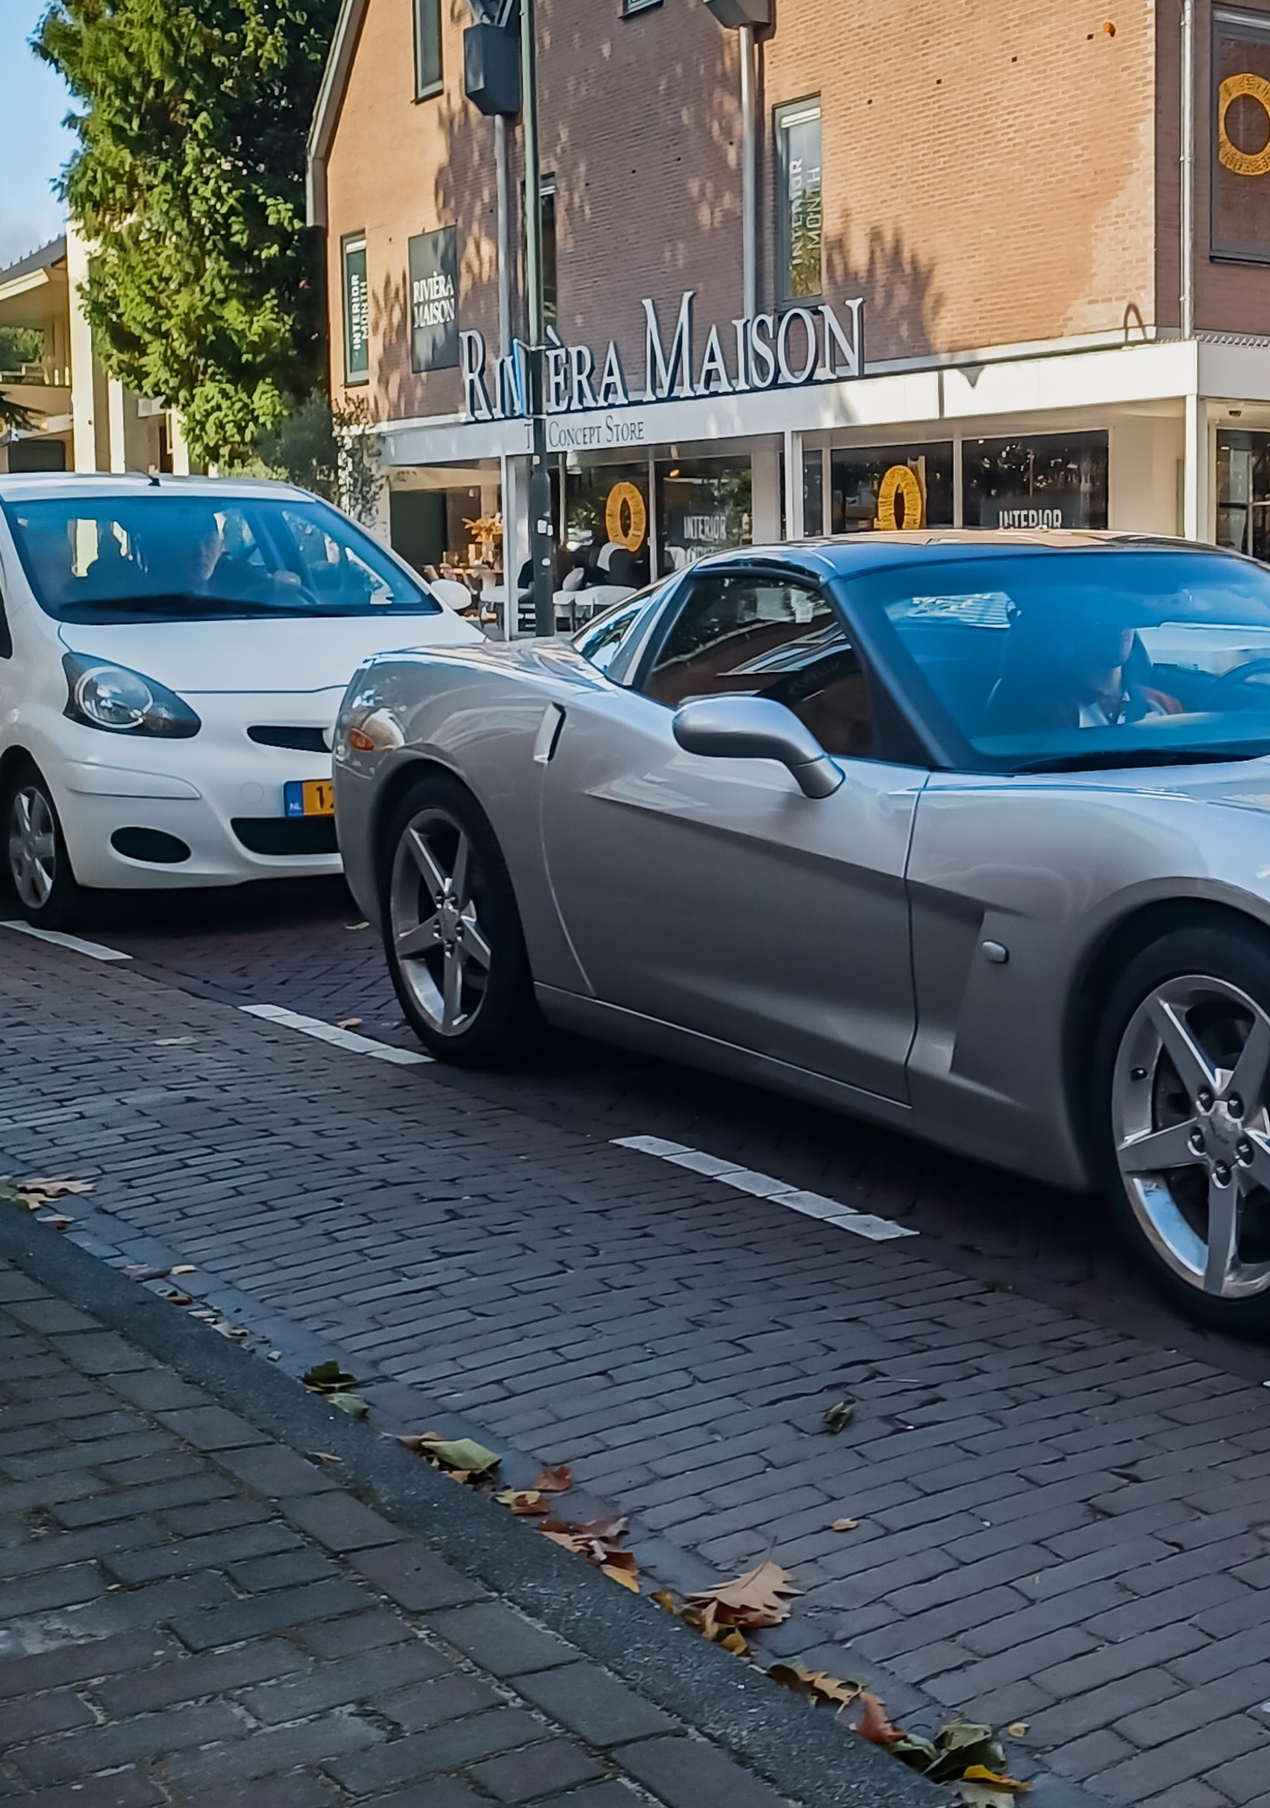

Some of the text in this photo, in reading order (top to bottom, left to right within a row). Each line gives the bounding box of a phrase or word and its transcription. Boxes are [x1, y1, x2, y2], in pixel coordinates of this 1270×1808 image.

[790, 158, 803, 266] INTERIOR
[806, 167, 821, 249] MONTH
[351, 274, 361, 350] INTERIOR
[360, 282, 368, 340] MONTH
[413, 270, 454, 303] RIVIÈRA
[413, 298, 455, 328] MAISON
[642, 291, 864, 401] MAISON
[683, 515, 727, 541] INTERIOR
[999, 509, 1062, 528] INTERIOR
